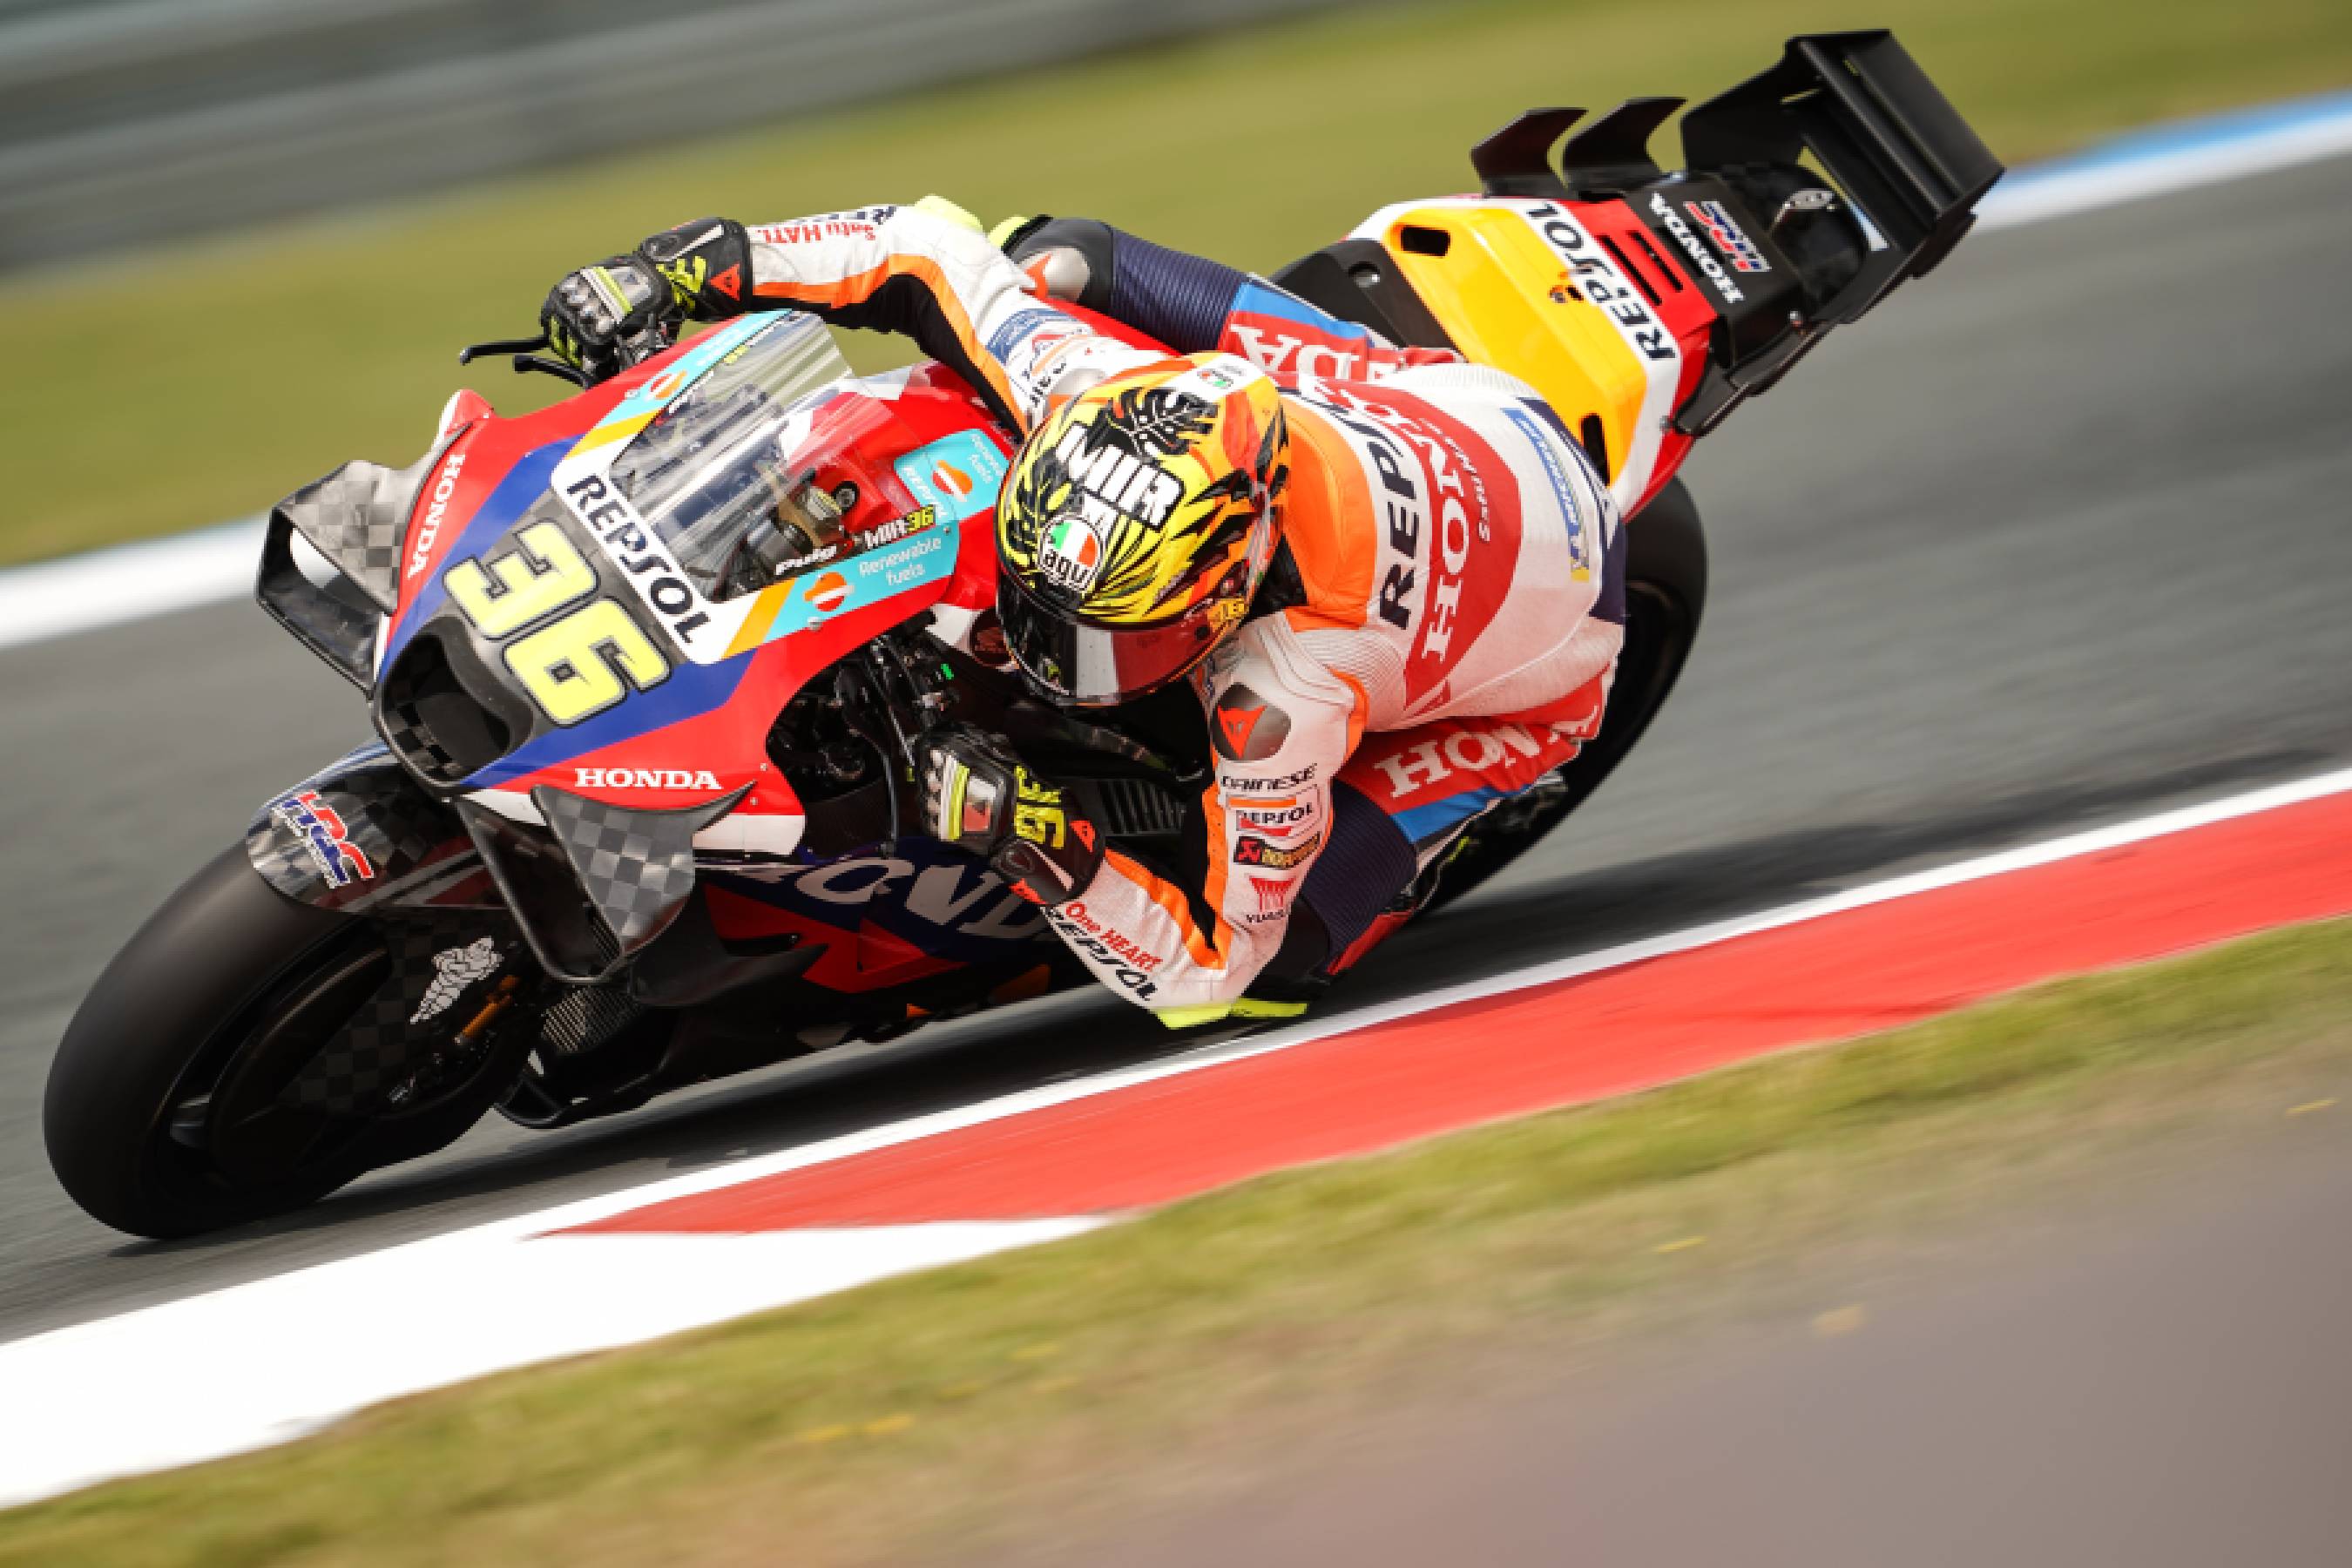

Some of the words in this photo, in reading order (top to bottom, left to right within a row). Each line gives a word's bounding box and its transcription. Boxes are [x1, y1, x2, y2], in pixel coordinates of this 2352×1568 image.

[1528, 202, 1677, 361] REPSOL
[1649, 191, 1746, 303] HONDA
[406, 453, 466, 579] HONDA
[1055, 421, 1185, 531] MIR
[566, 474, 713, 645] REPSOL
[858, 537, 942, 577] Renewable
[885, 563, 926, 586] fuels
[442, 517, 673, 729] 36
[573, 767, 723, 791] HONDA
[1221, 762, 1318, 792] DAINESE
[1065, 902, 1101, 932] One
[1098, 928, 1164, 972] HEART
